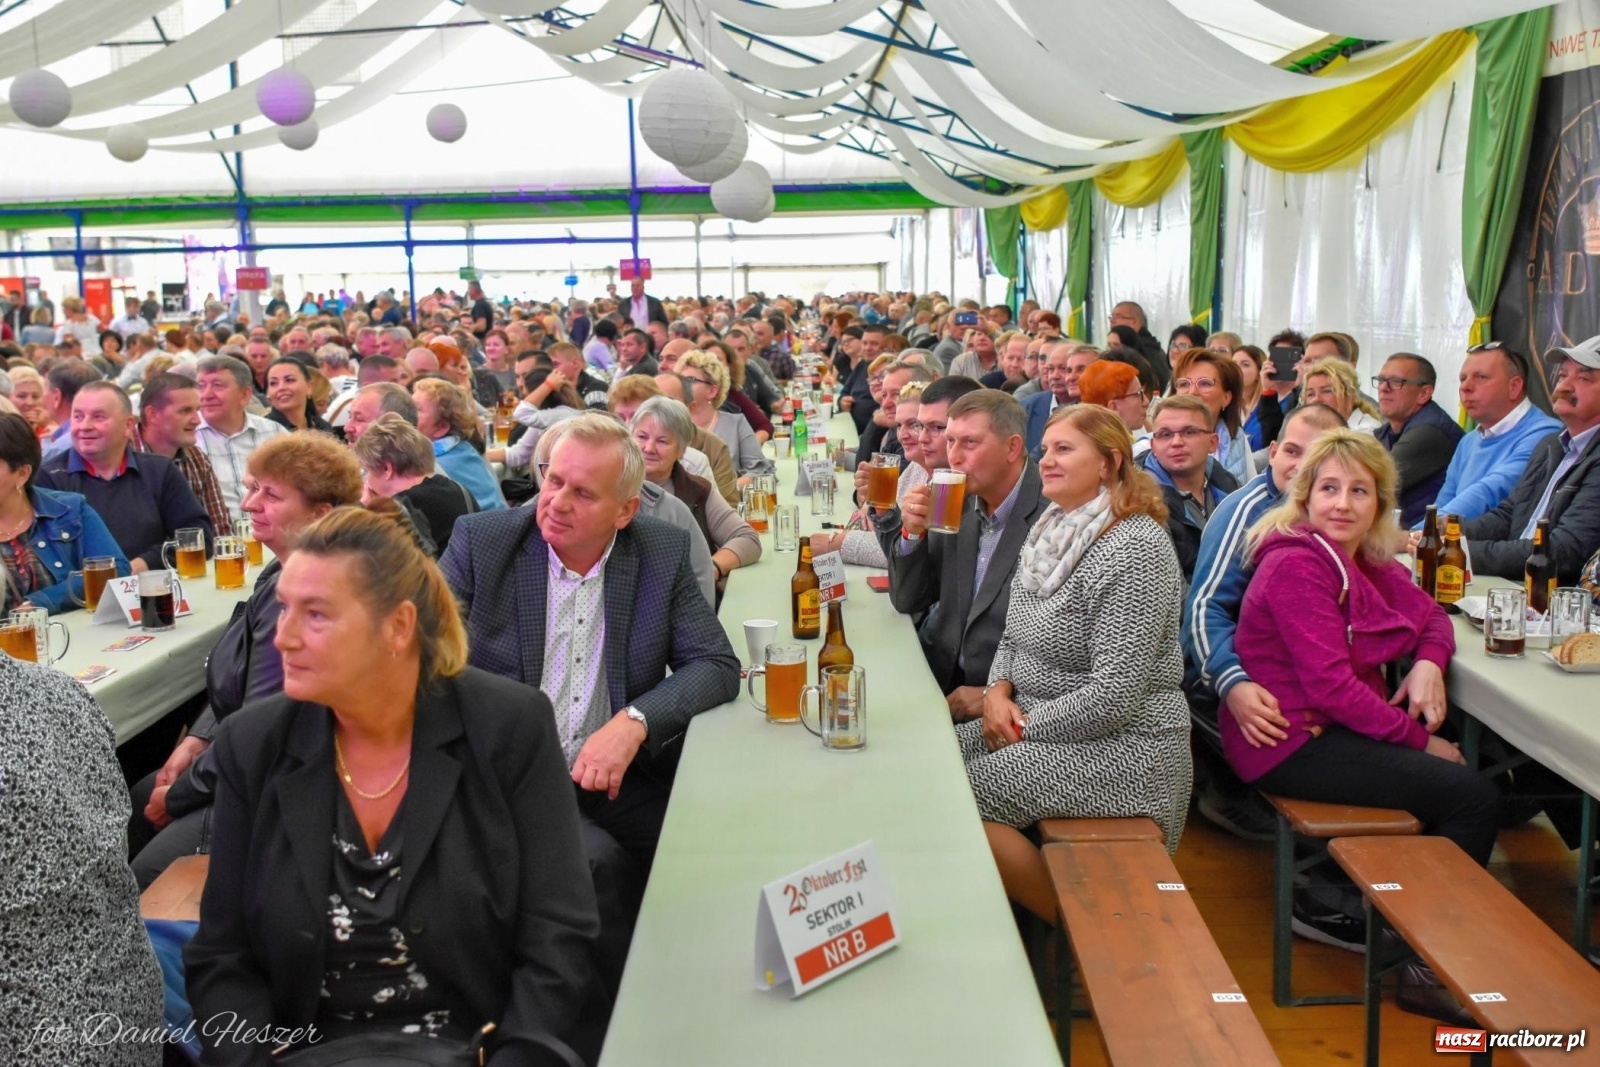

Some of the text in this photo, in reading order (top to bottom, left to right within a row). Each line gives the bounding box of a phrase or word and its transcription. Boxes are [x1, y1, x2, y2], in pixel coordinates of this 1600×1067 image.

[1592, 28, 1600, 48] T
[829, 587, 835, 599] 9
[806, 891, 864, 930] SEKTOR I
[827, 918, 853, 937] STOLIK
[823, 937, 853, 968] NR
